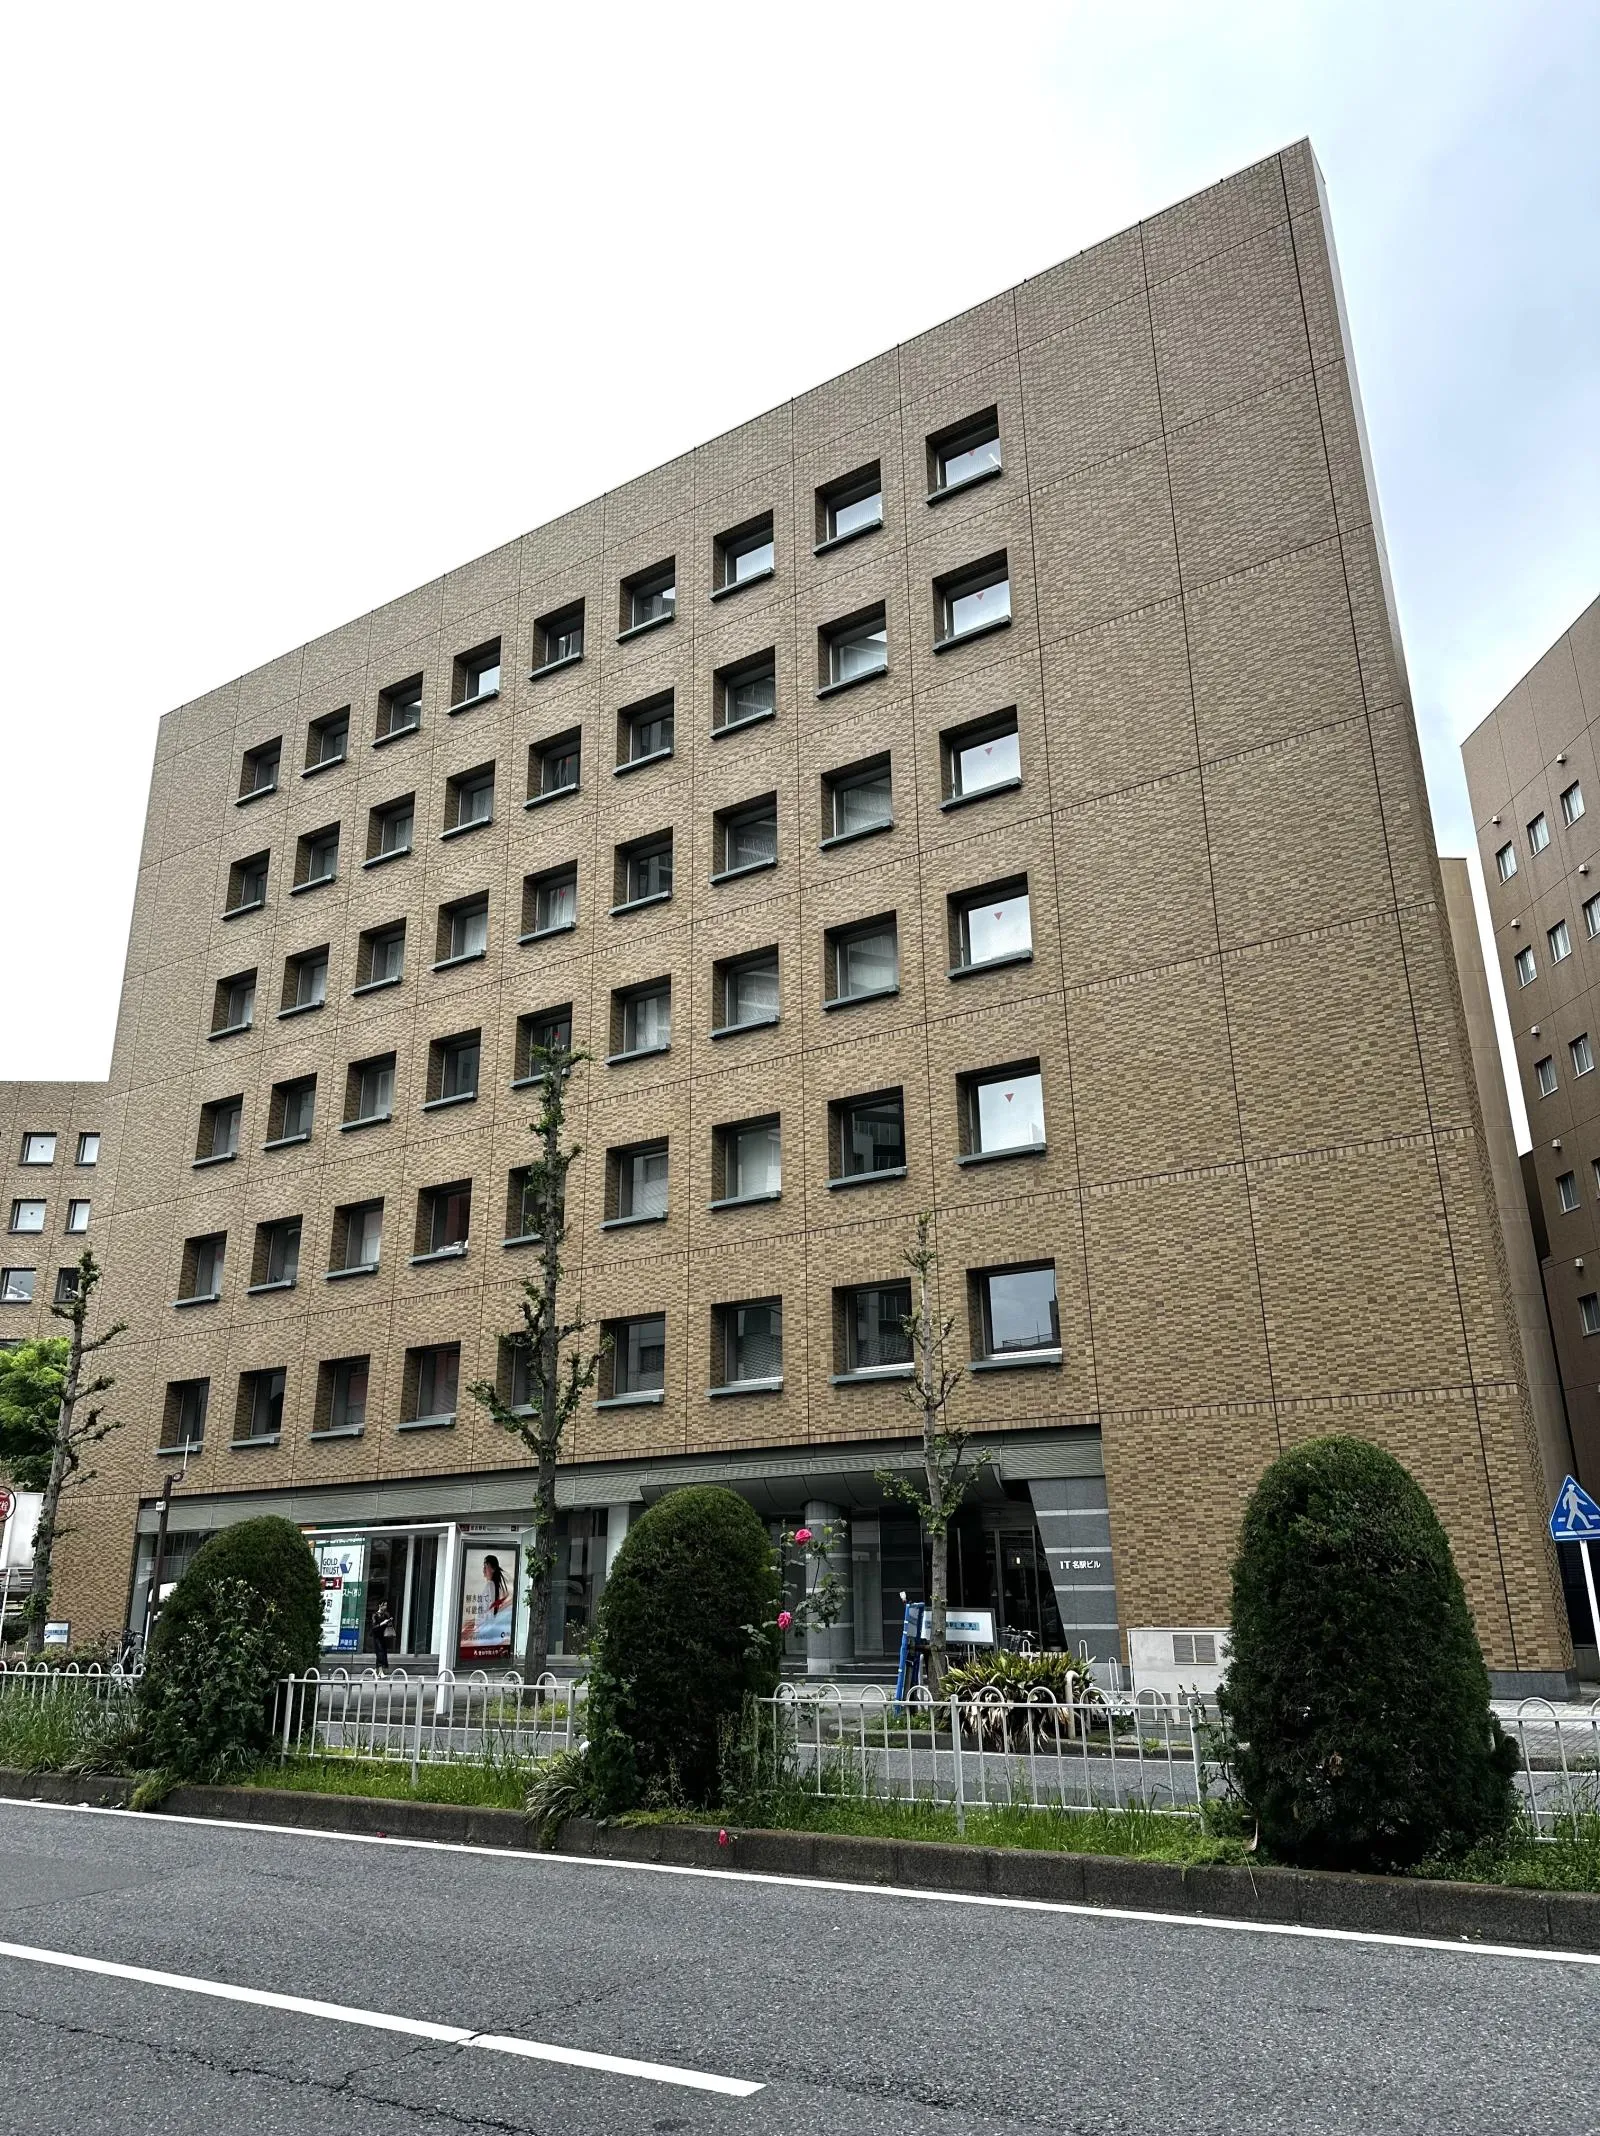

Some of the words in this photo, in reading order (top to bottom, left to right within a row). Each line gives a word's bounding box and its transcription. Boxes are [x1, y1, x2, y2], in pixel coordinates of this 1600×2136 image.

[323, 1558, 338, 1566] GOLD
[1060, 1560, 1071, 1570] IT
[1072, 1560, 1101, 1569] 名駅ビル
[323, 1566, 339, 1575] TRUST
[335, 1578, 340, 1588] 1
